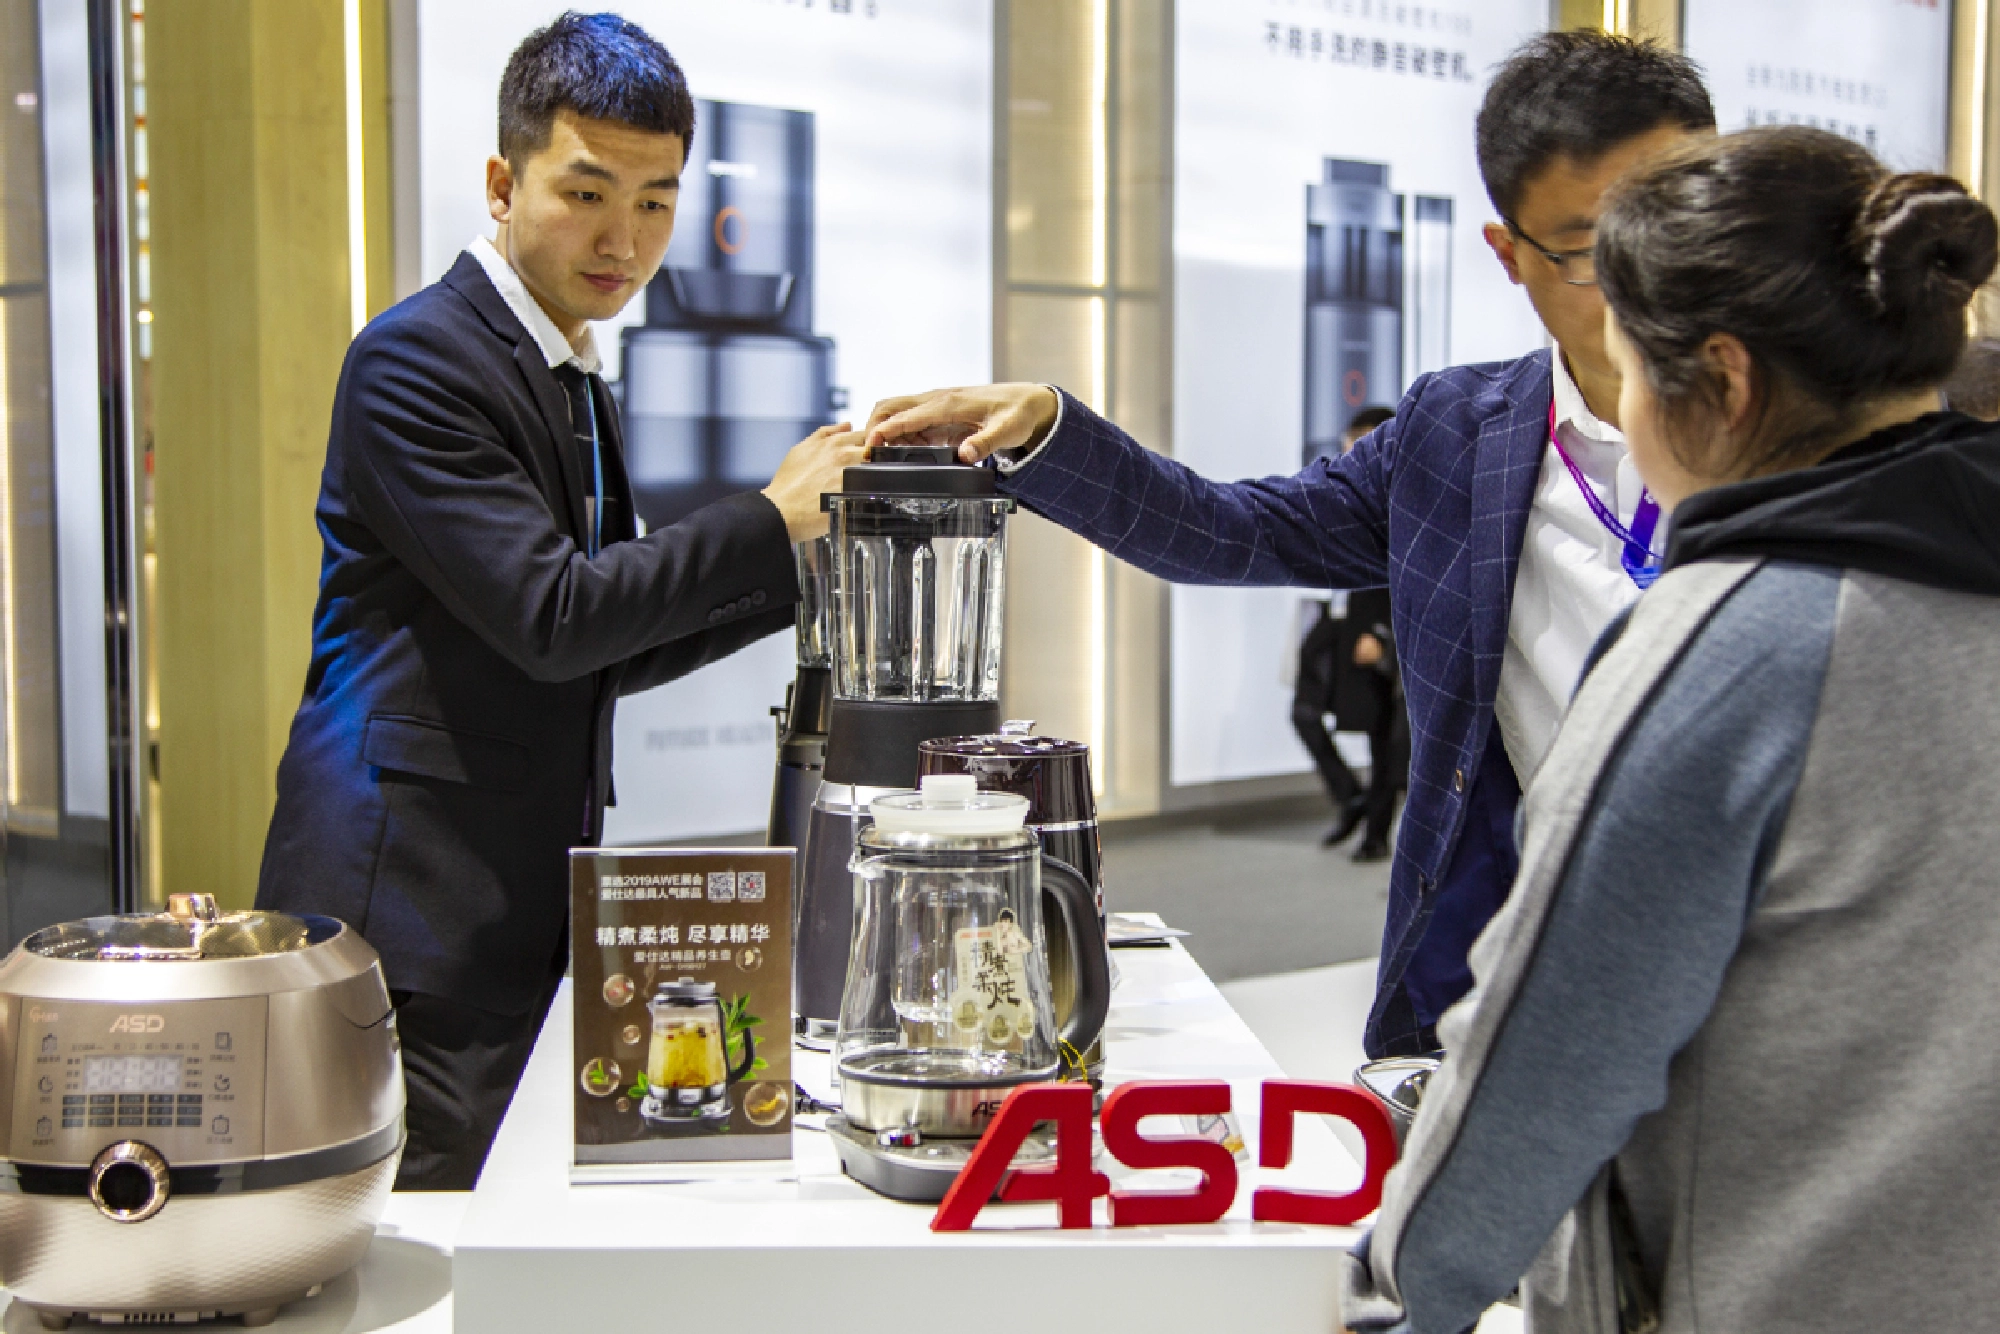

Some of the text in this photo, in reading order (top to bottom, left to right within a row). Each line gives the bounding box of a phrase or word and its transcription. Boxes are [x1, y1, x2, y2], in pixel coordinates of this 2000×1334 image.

[596, 923, 771, 946] 精煮柔炖 尽享精华
[108, 1013, 166, 1033] ASD
[931, 1078, 1398, 1232] ASD
